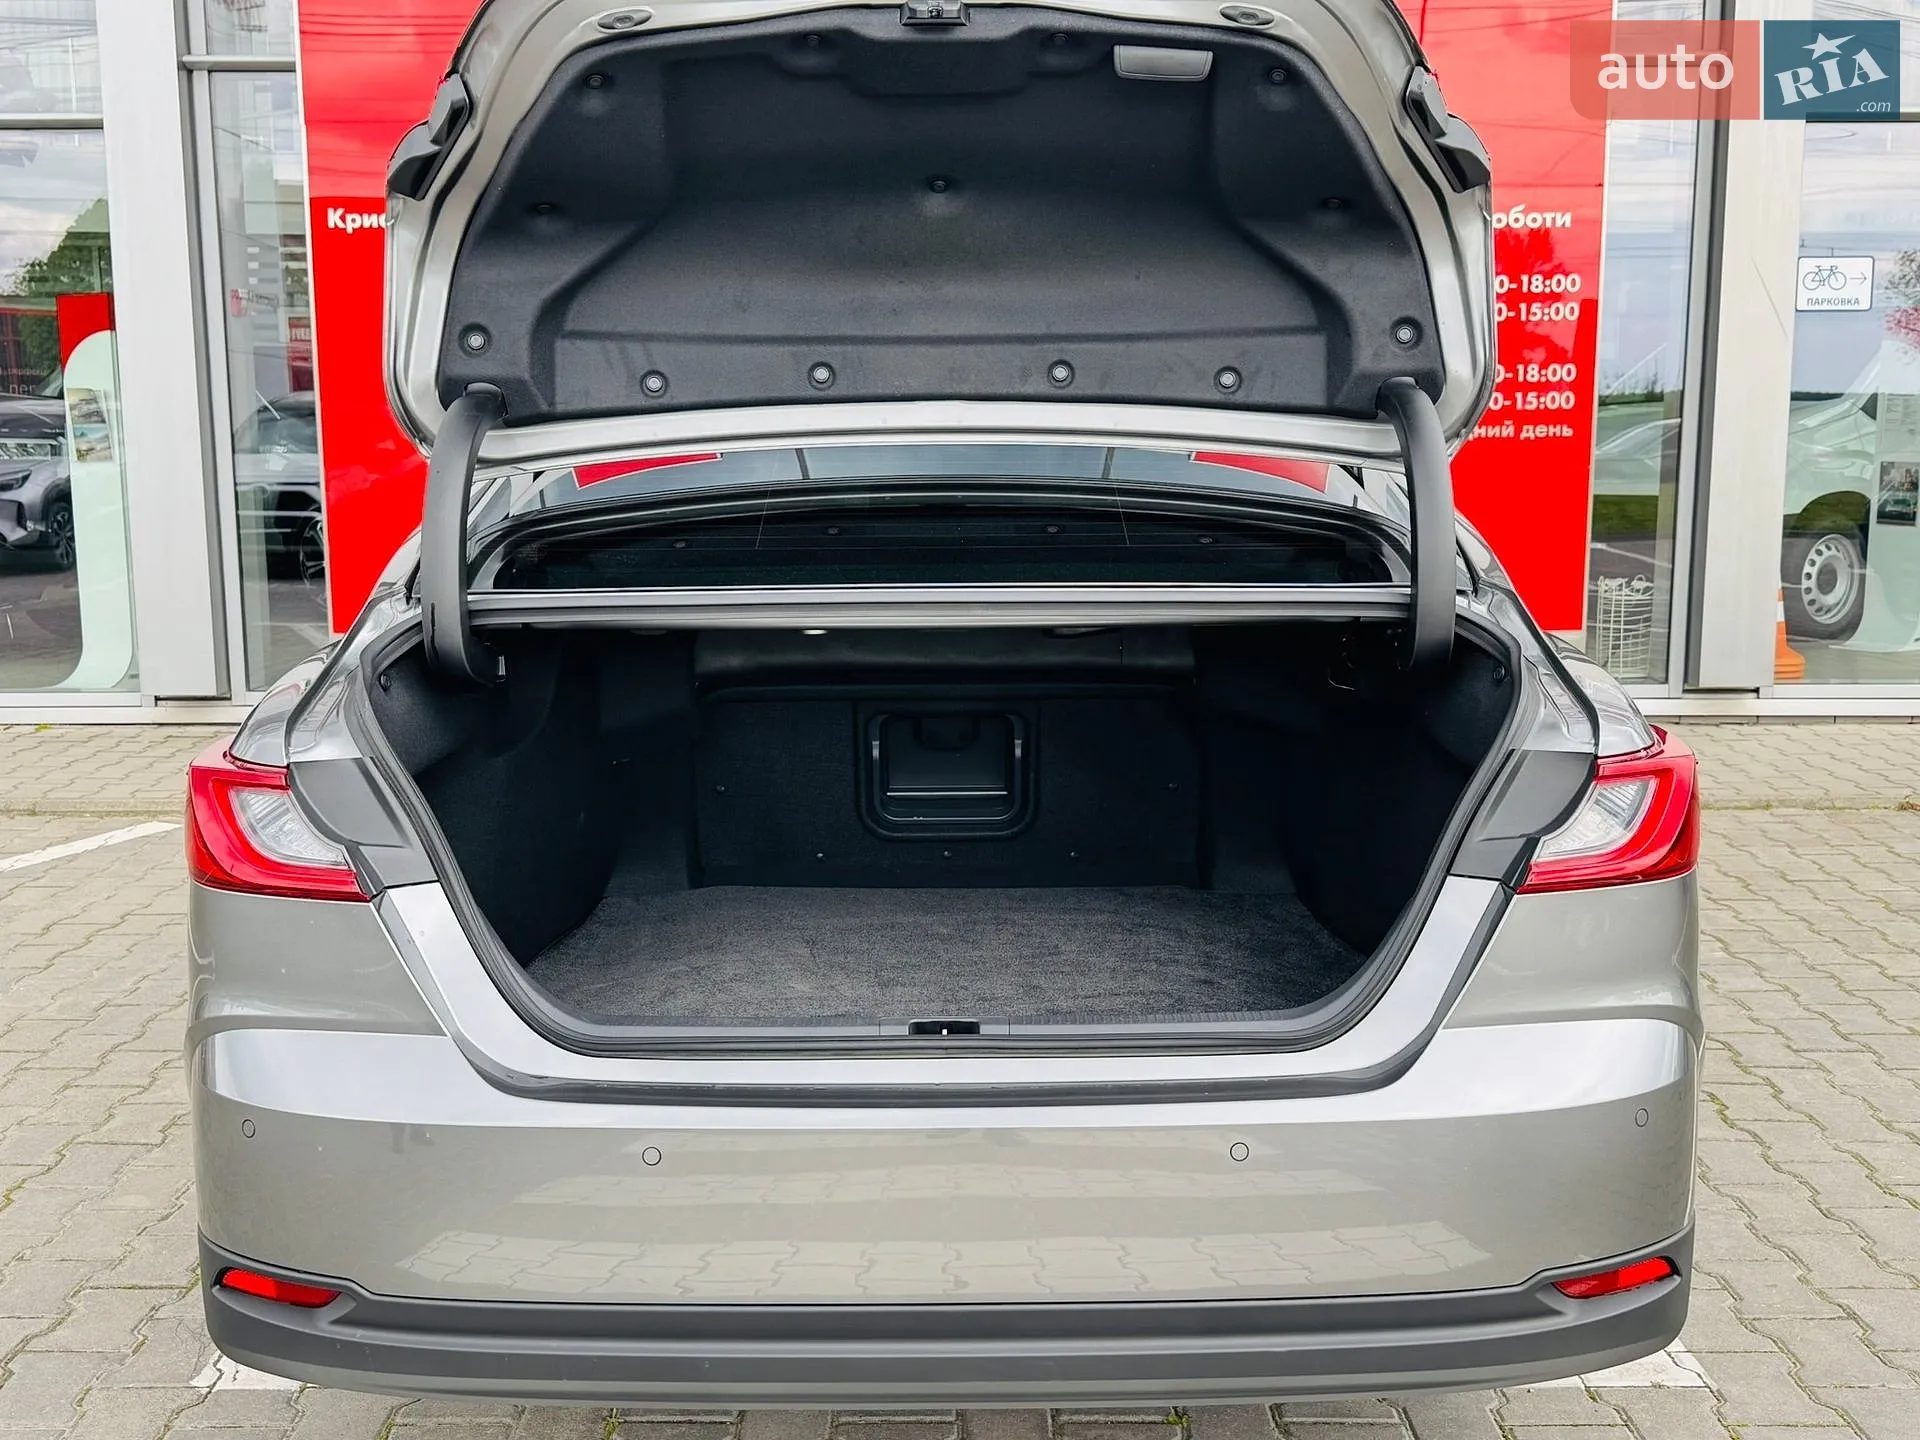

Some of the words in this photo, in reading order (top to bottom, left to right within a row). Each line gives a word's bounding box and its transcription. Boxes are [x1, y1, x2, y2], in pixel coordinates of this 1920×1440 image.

[1807, 297, 1860, 307] ПАРКОВКА
[1469, 420, 1515, 440] ний
[1520, 424, 1574, 440] день
